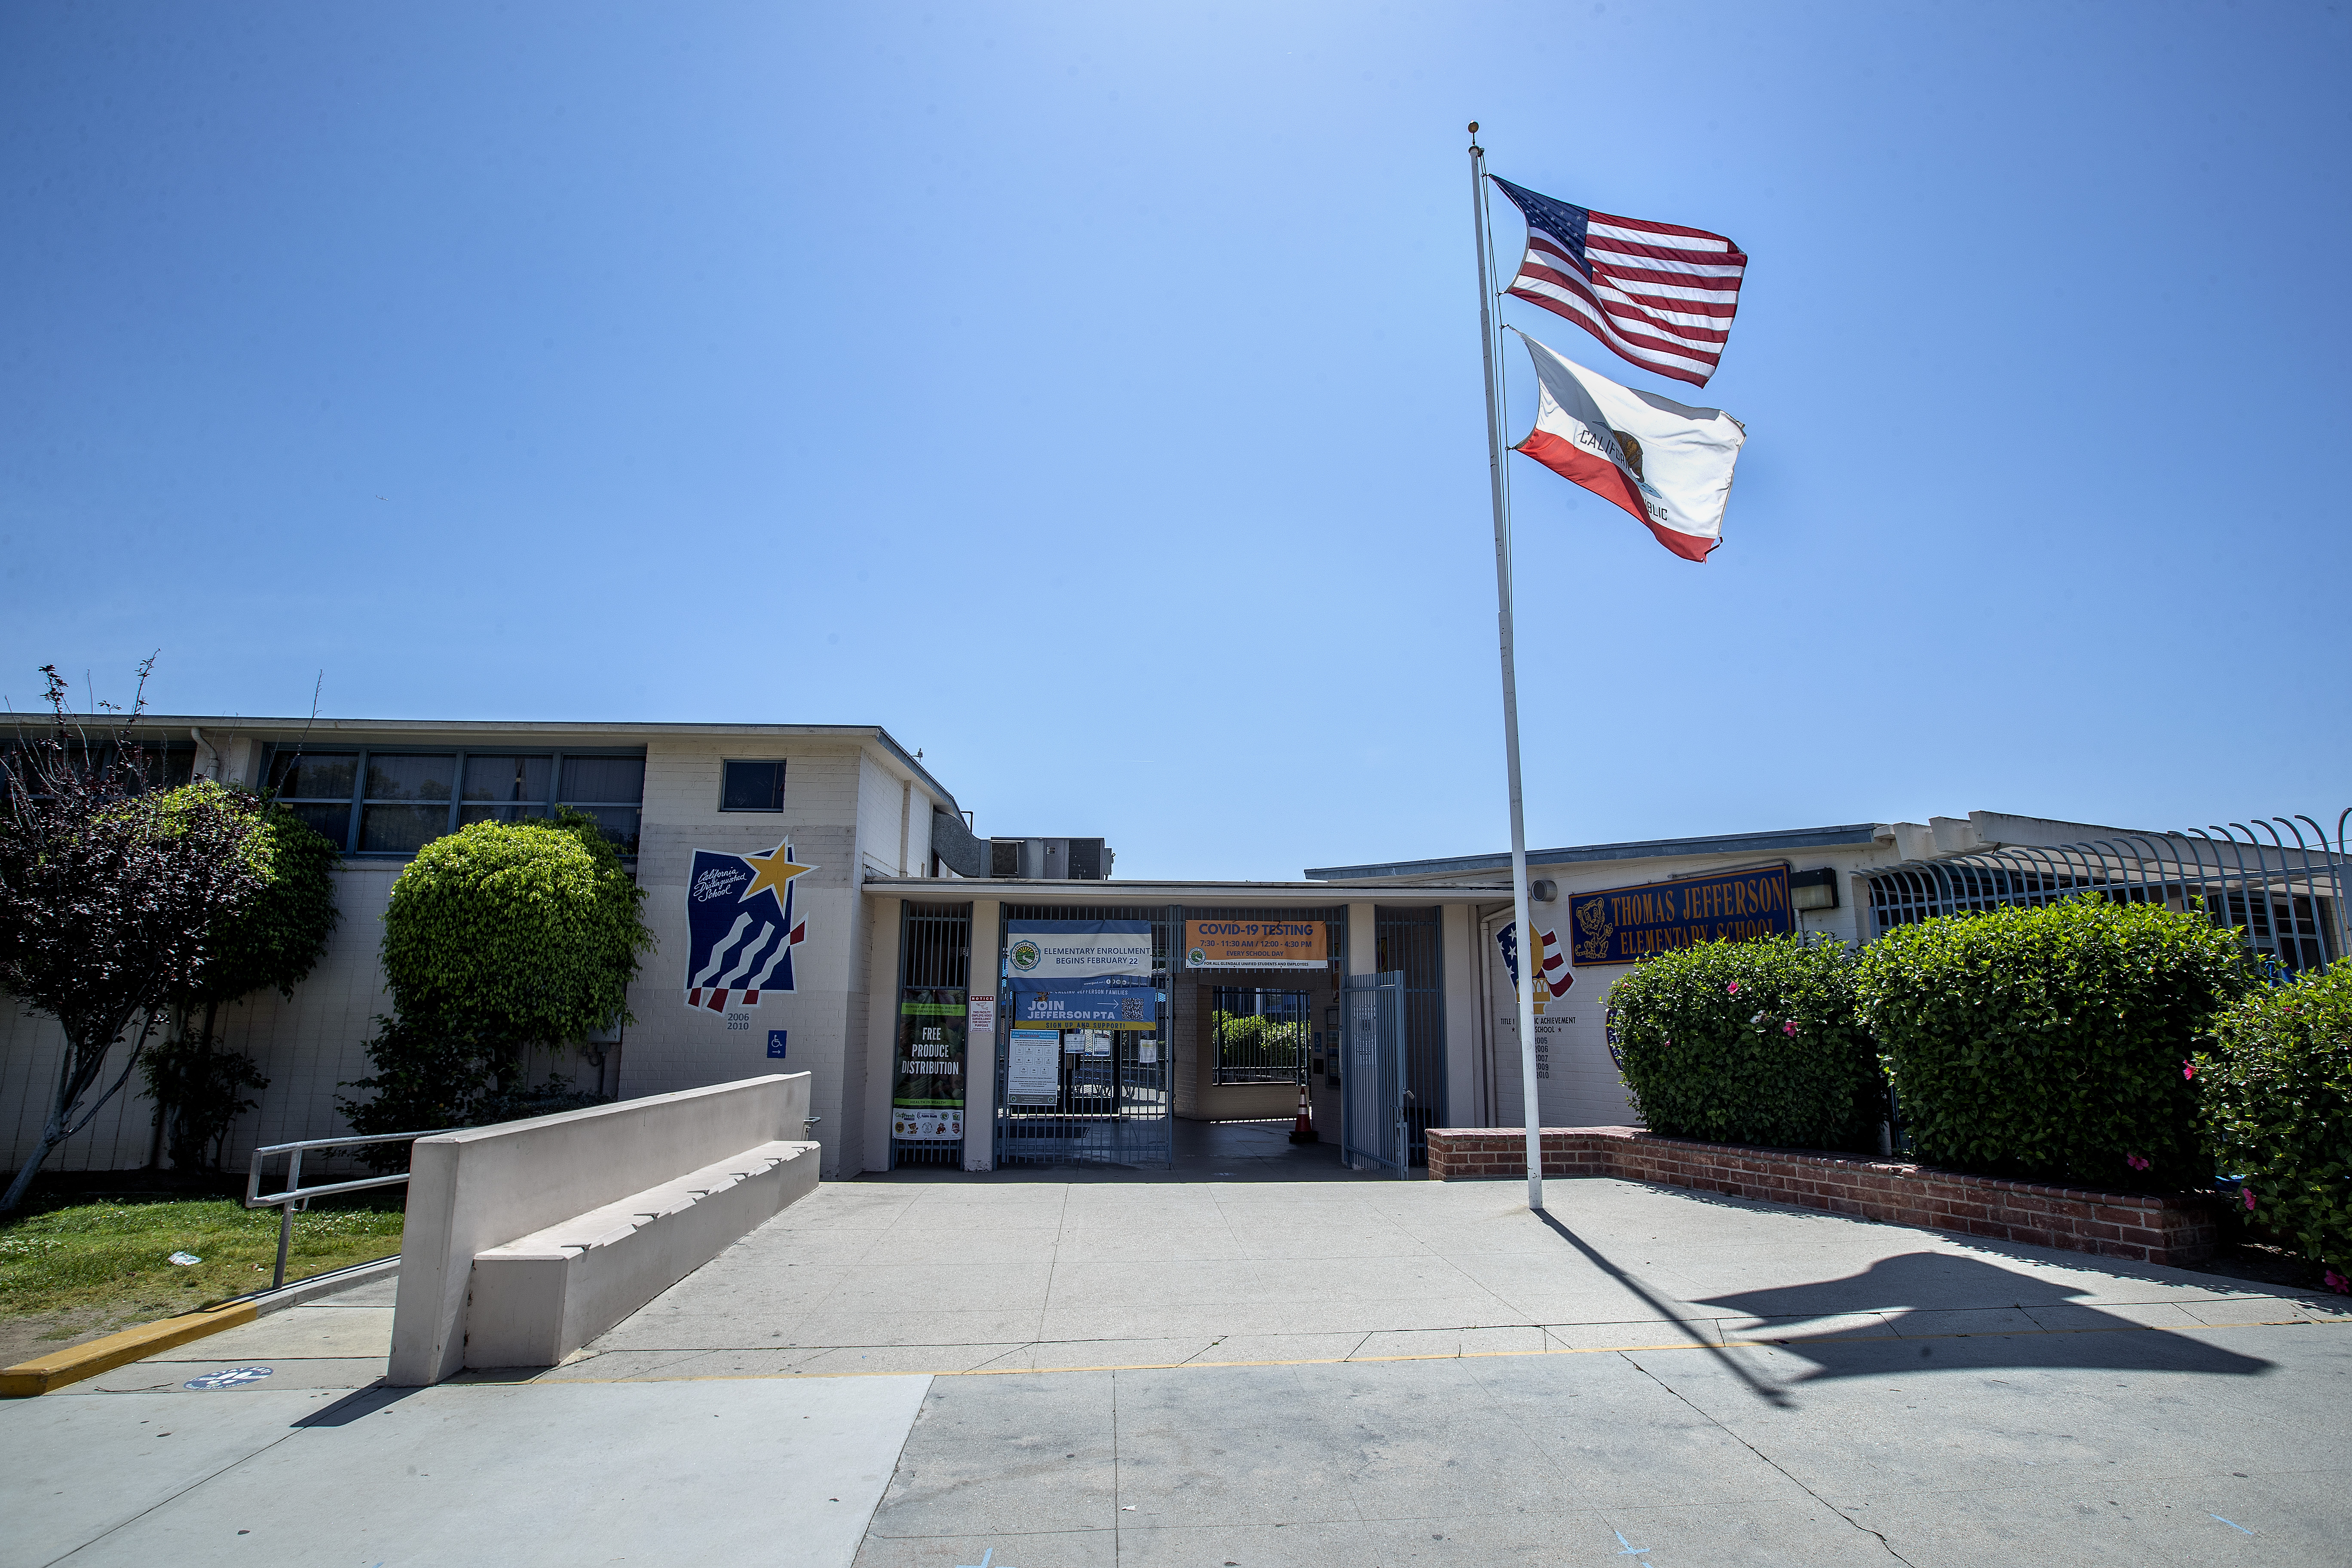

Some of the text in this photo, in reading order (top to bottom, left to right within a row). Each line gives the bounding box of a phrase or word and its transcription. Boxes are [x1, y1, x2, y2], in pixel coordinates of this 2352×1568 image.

[1580, 430, 1632, 475] CALIFORN
[1643, 496, 1667, 521] BLIC
[698, 867, 738, 883] California
[693, 873, 747, 896] Distinguished
[698, 884, 732, 902] School
[1611, 876, 1784, 927] THOMAS JEFFERSON
[1198, 923, 1313, 936] COVID-19 TESTING
[1013, 943, 1038, 956] GLENDALE UNIFIED
[1013, 959, 1037, 969] SCHOOL DISTRICT
[1027, 1001, 1064, 1011] JOIN
[1027, 1011, 1090, 1019] JEFFERSON
[922, 1027, 941, 1040] FREE
[912, 1044, 949, 1057] PRODUCE
[901, 1060, 959, 1075] DISTRIBUTION
[210, 1367, 248, 1375] STAY
